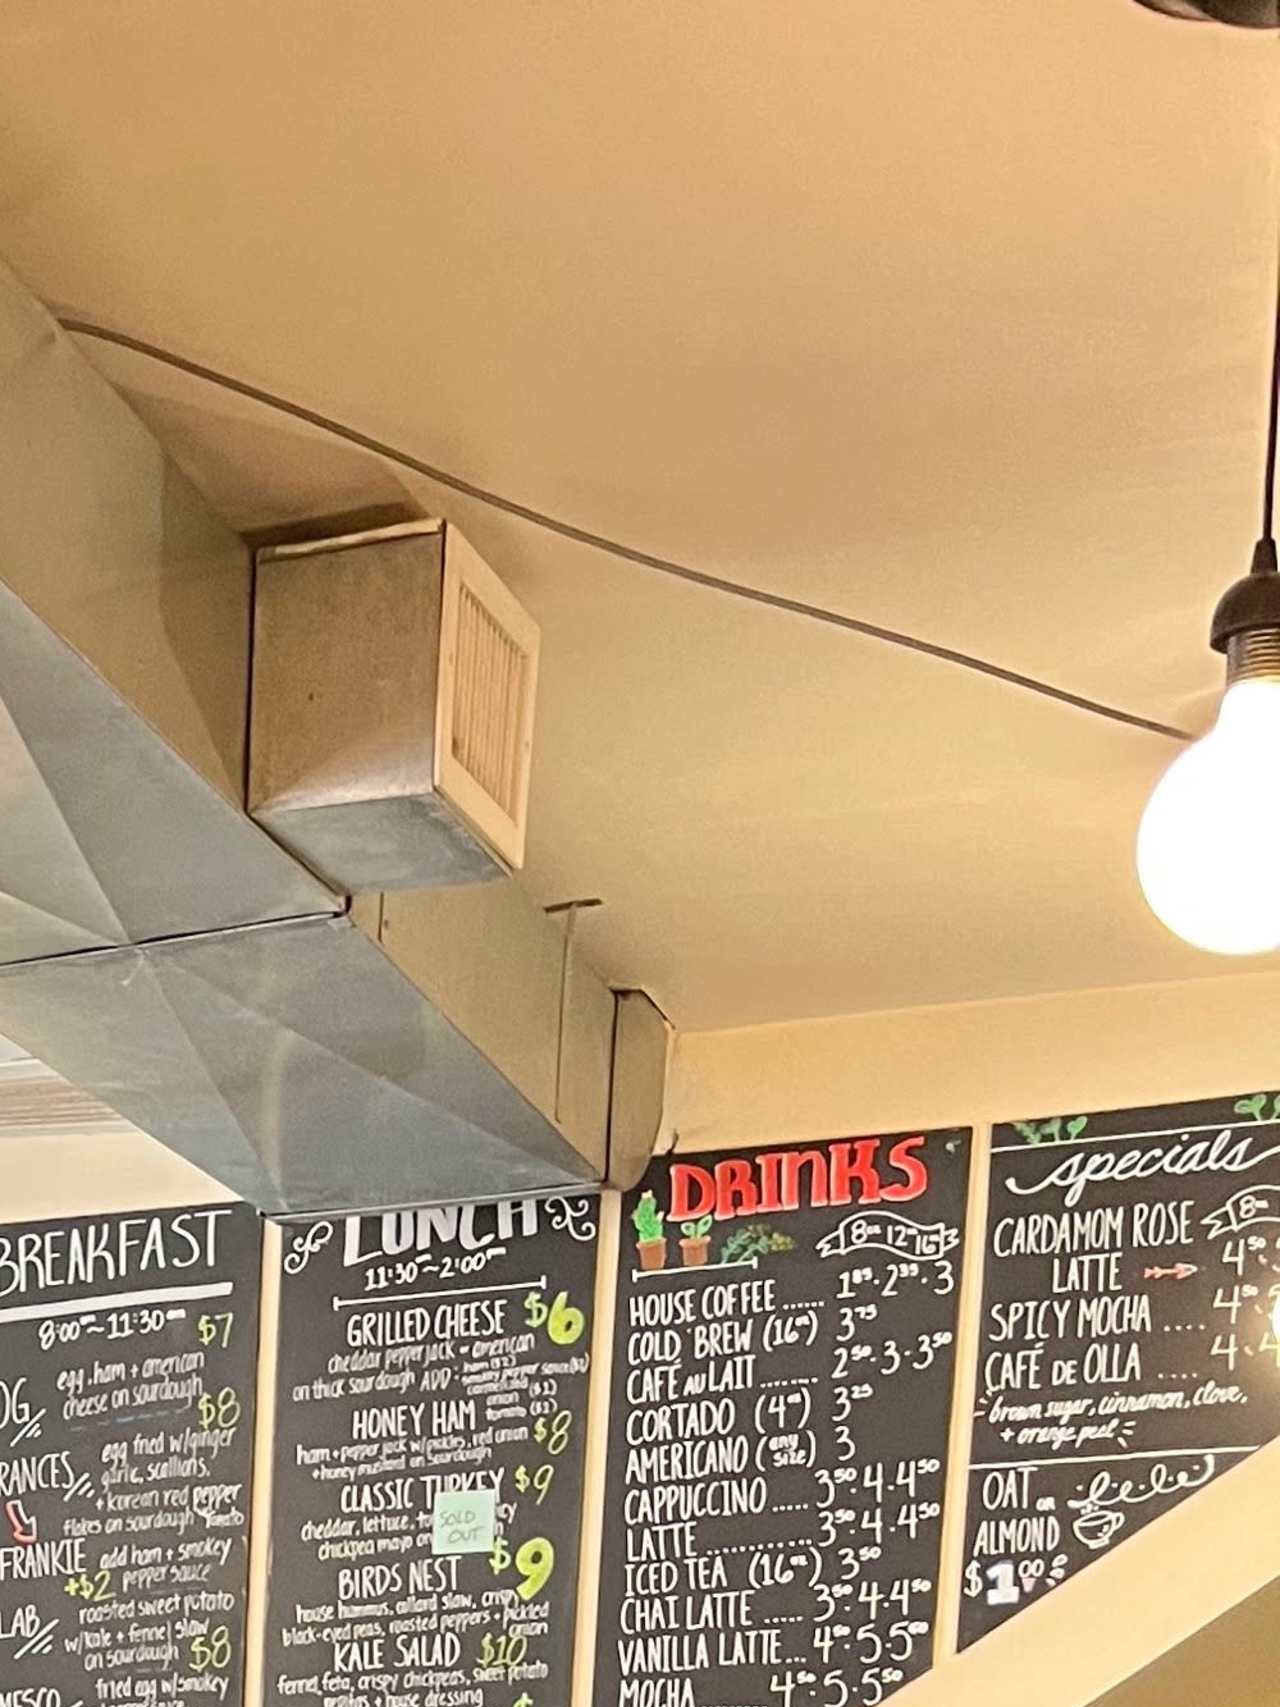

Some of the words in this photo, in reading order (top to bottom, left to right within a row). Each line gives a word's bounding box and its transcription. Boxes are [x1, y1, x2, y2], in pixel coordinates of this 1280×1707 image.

[667, 1136, 928, 1222] DRINKS
[1006, 1130, 1260, 1207] specials
[344, 1200, 538, 1267] LUNCH
[994, 1206, 1124, 1256] CARDAMOM
[1133, 1201, 1194, 1247] ROSE
[1053, 1252, 1122, 1293] LATTE
[630, 1289, 696, 1326] HOUSE
[702, 1279, 776, 1318] COFFEE
[934, 1261, 954, 1294] 3
[199, 1312, 233, 1348] $7
[348, 1307, 430, 1346] GRILLED
[434, 1300, 508, 1339] CHEESE
[525, 1291, 585, 1344] $6
[990, 1300, 1070, 1340] SPICY
[1078, 1294, 1151, 1338] MOCHA
[328, 1348, 382, 1374] cheddar
[472, 1334, 535, 1358] american
[629, 1332, 681, 1365] COLD
[694, 1318, 754, 1359] BREW
[142, 1352, 204, 1378] american
[292, 1385, 310, 1401] on
[350, 1369, 415, 1392] sourdough
[627, 1358, 682, 1405] CAFÉ
[684, 1375, 706, 1395] AU
[708, 1355, 755, 1392] LAIT
[985, 1343, 1043, 1390] CAFÉ
[1052, 1360, 1077, 1386] DE
[1083, 1343, 1140, 1383] OLLA
[64, 1395, 107, 1420] cheese
[112, 1388, 129, 1408] on
[132, 1376, 203, 1407] sourdough
[199, 1387, 240, 1429] $8
[989, 1396, 1041, 1423] brown
[353, 1401, 424, 1440] HONEY
[433, 1401, 476, 1435] HAM
[534, 1410, 572, 1454] $8
[627, 1399, 735, 1446] CORTADO
[1018, 1424, 1075, 1450] orange
[1076, 1419, 1118, 1447] peel
[102, 1443, 128, 1470] egg
[133, 1434, 164, 1454] fried
[297, 1444, 330, 1464] ham
[474, 1428, 492, 1448] red
[625, 1435, 748, 1484] AMERICANO
[835, 1426, 855, 1460] 3
[107, 1490, 158, 1513] korean
[163, 1486, 188, 1500] red
[193, 1485, 241, 1508] pepper
[341, 1479, 413, 1514] CLASSIC
[516, 1464, 554, 1504] $9
[625, 1477, 766, 1524] CAPPUCCINO
[863, 1462, 883, 1503] 4
[982, 1467, 1038, 1510] OAT
[1036, 1498, 1055, 1511] OR
[105, 1516, 122, 1533] on
[126, 1508, 194, 1535] sourdough
[448, 1529, 488, 1544] OUT
[627, 1522, 696, 1562] LATTE
[861, 1508, 882, 1544] 4
[973, 1517, 1060, 1556] ALMOND
[0, 1538, 87, 1581] FRANKIE
[100, 1547, 128, 1568] add
[131, 1545, 162, 1565] ham
[178, 1537, 232, 1564] smokey
[377, 1535, 412, 1552] mayo
[64, 1571, 116, 1601] +$2
[122, 1570, 167, 1592] pepper
[170, 1564, 212, 1583] sauce
[340, 1564, 402, 1600] BIRDS
[409, 1556, 462, 1594] NEST
[490, 1536, 554, 1600] $9
[626, 1563, 677, 1597] ICED
[684, 1557, 727, 1589] TEA
[79, 1599, 135, 1624] roasted
[139, 1597, 181, 1617] sweet
[184, 1593, 234, 1616] potato
[297, 1605, 335, 1624] house
[621, 1596, 679, 1634] CHAI
[686, 1589, 755, 1630] LATTE
[858, 1582, 884, 1619] 4
[128, 1622, 171, 1643] fennel
[190, 1626, 231, 1671] $8
[334, 1640, 384, 1673] KALE
[394, 1632, 460, 1668] SALAD
[477, 1632, 528, 1668] $10
[618, 1637, 708, 1676] VANILLA
[719, 1630, 782, 1665] LATTE
[857, 1624, 882, 1663] 5
[84, 1652, 103, 1671] on
[107, 1643, 179, 1670] sourdough
[95, 1676, 131, 1699] fried
[135, 1680, 157, 1700] egg
